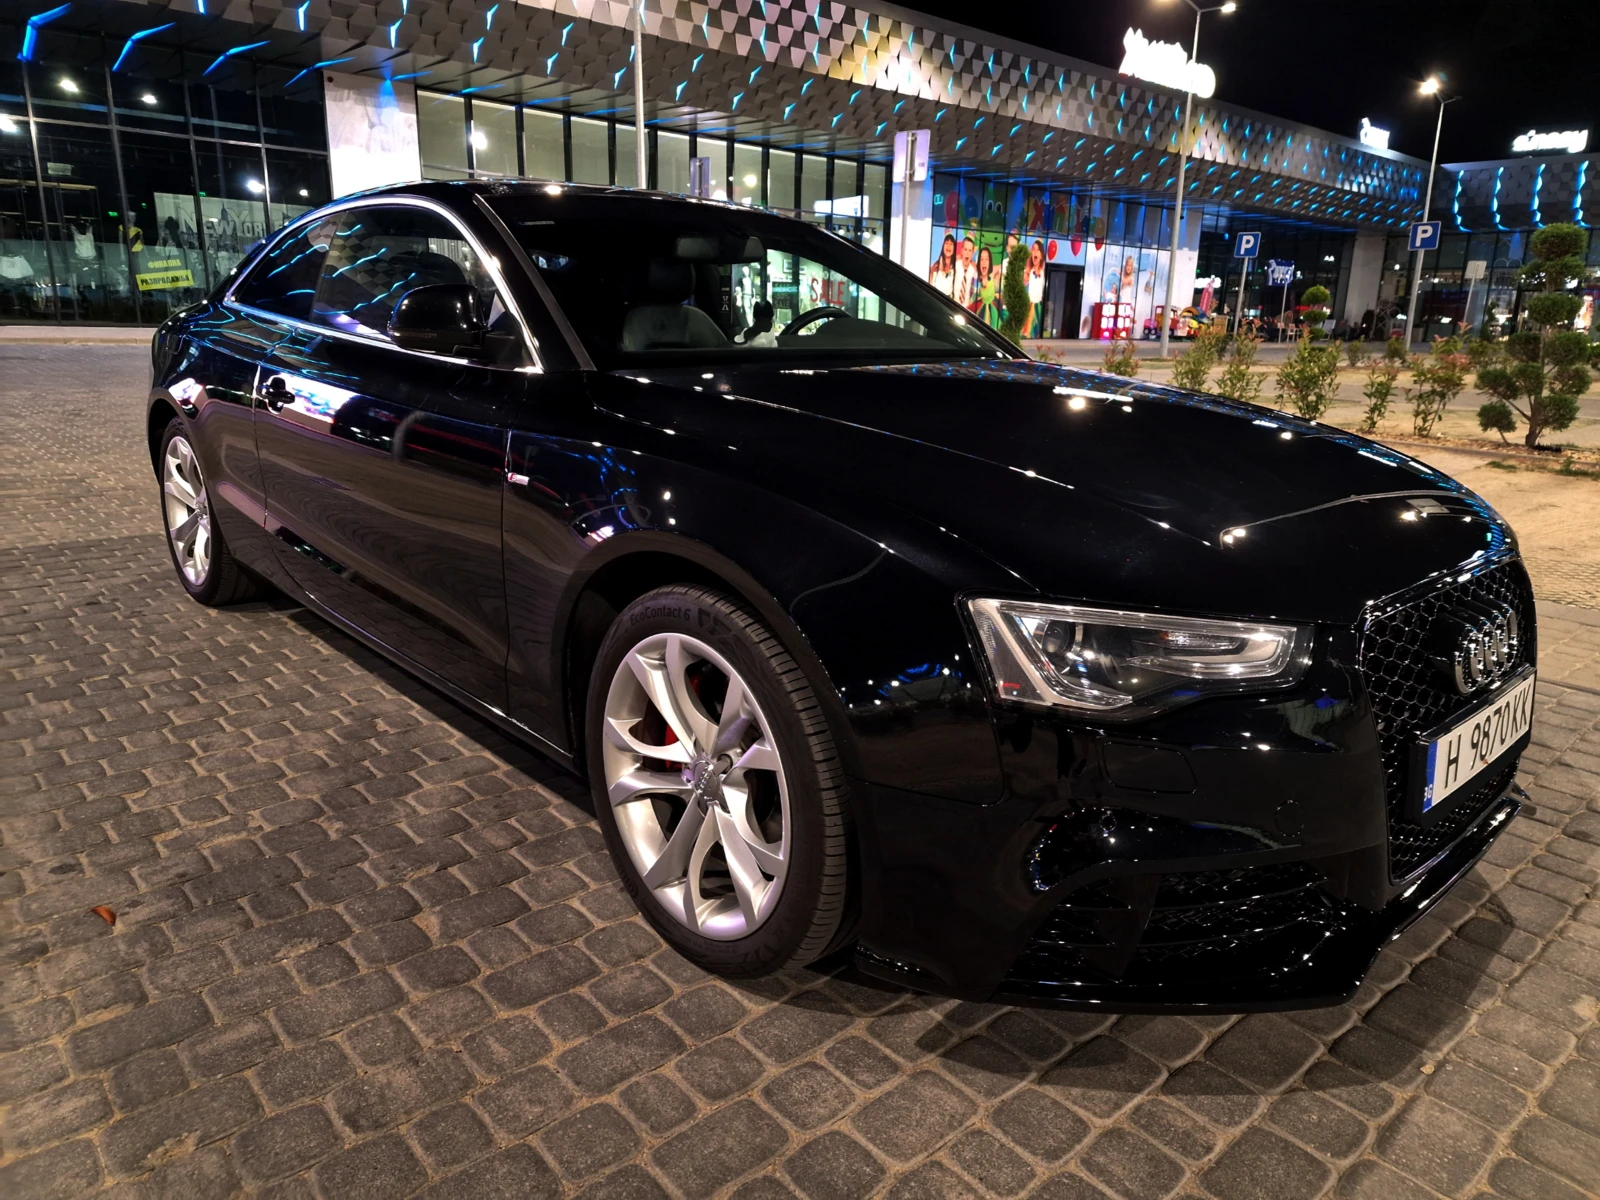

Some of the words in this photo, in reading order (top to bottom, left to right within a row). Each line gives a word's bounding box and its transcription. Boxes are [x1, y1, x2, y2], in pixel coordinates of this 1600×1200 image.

[1240, 235, 1254, 254] P
[1415, 226, 1433, 247] P
[141, 275, 189, 285] РАЗПРОДАЖБА
[810, 277, 844, 305] SALE
[630, 605, 680, 626] EcoContact
[683, 609, 691, 621] 6
[1444, 733, 1461, 789] H
